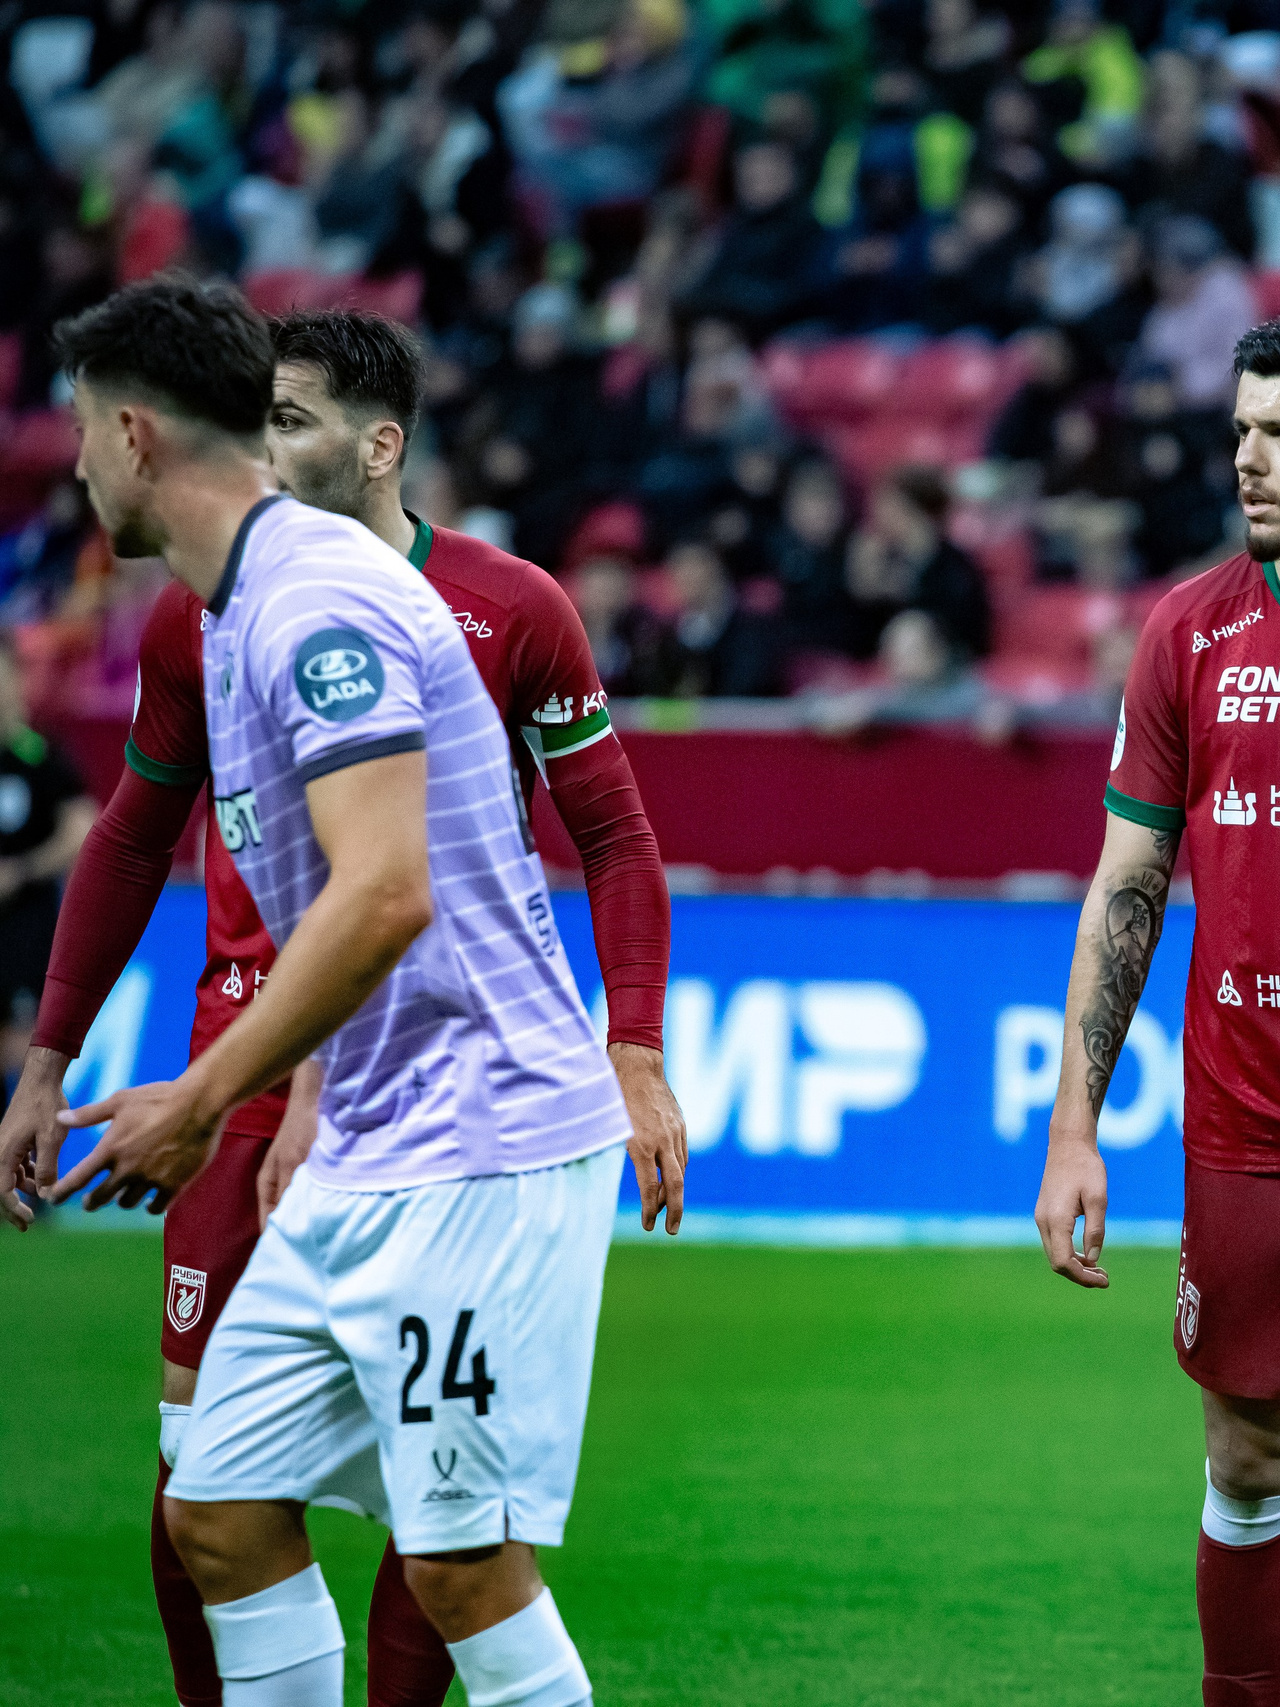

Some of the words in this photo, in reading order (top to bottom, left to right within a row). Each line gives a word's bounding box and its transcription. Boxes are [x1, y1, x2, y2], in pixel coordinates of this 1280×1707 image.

[1212, 607, 1265, 641] НКНХ
[311, 677, 377, 710] LADA
[596, 978, 926, 1155] ИР
[172, 1267, 206, 1283] РУБИН
[400, 1308, 496, 1425] 24
